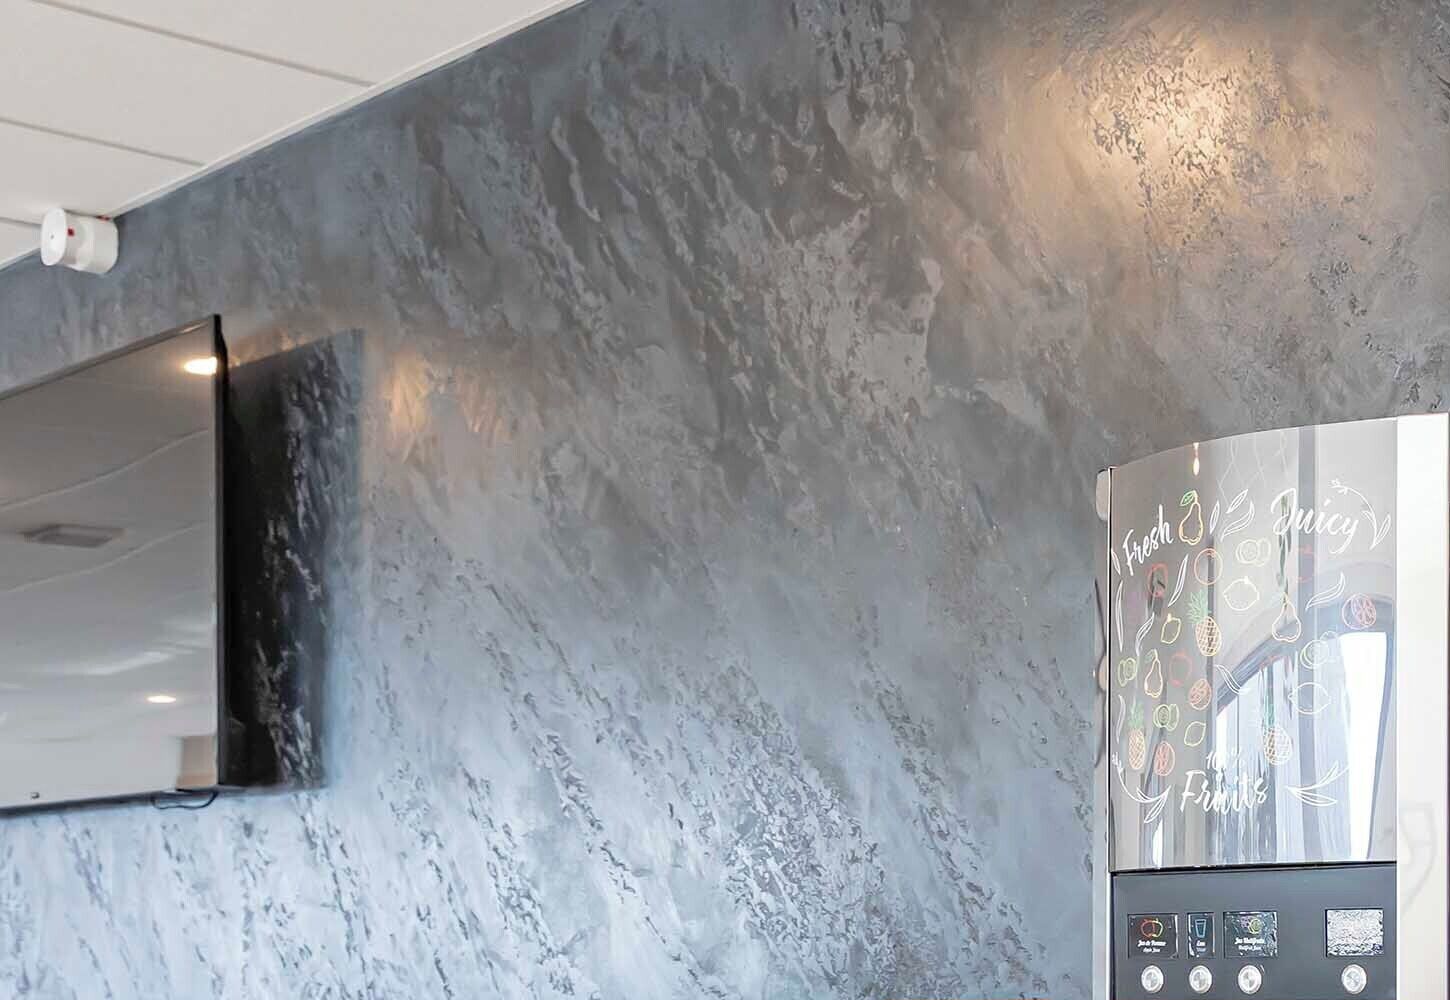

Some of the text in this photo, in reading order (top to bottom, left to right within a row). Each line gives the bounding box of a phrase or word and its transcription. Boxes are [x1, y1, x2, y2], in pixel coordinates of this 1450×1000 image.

[1122, 504, 1174, 577] Fresh
[1271, 487, 1359, 554] Juicy
[1180, 768, 1269, 815] Fruits
